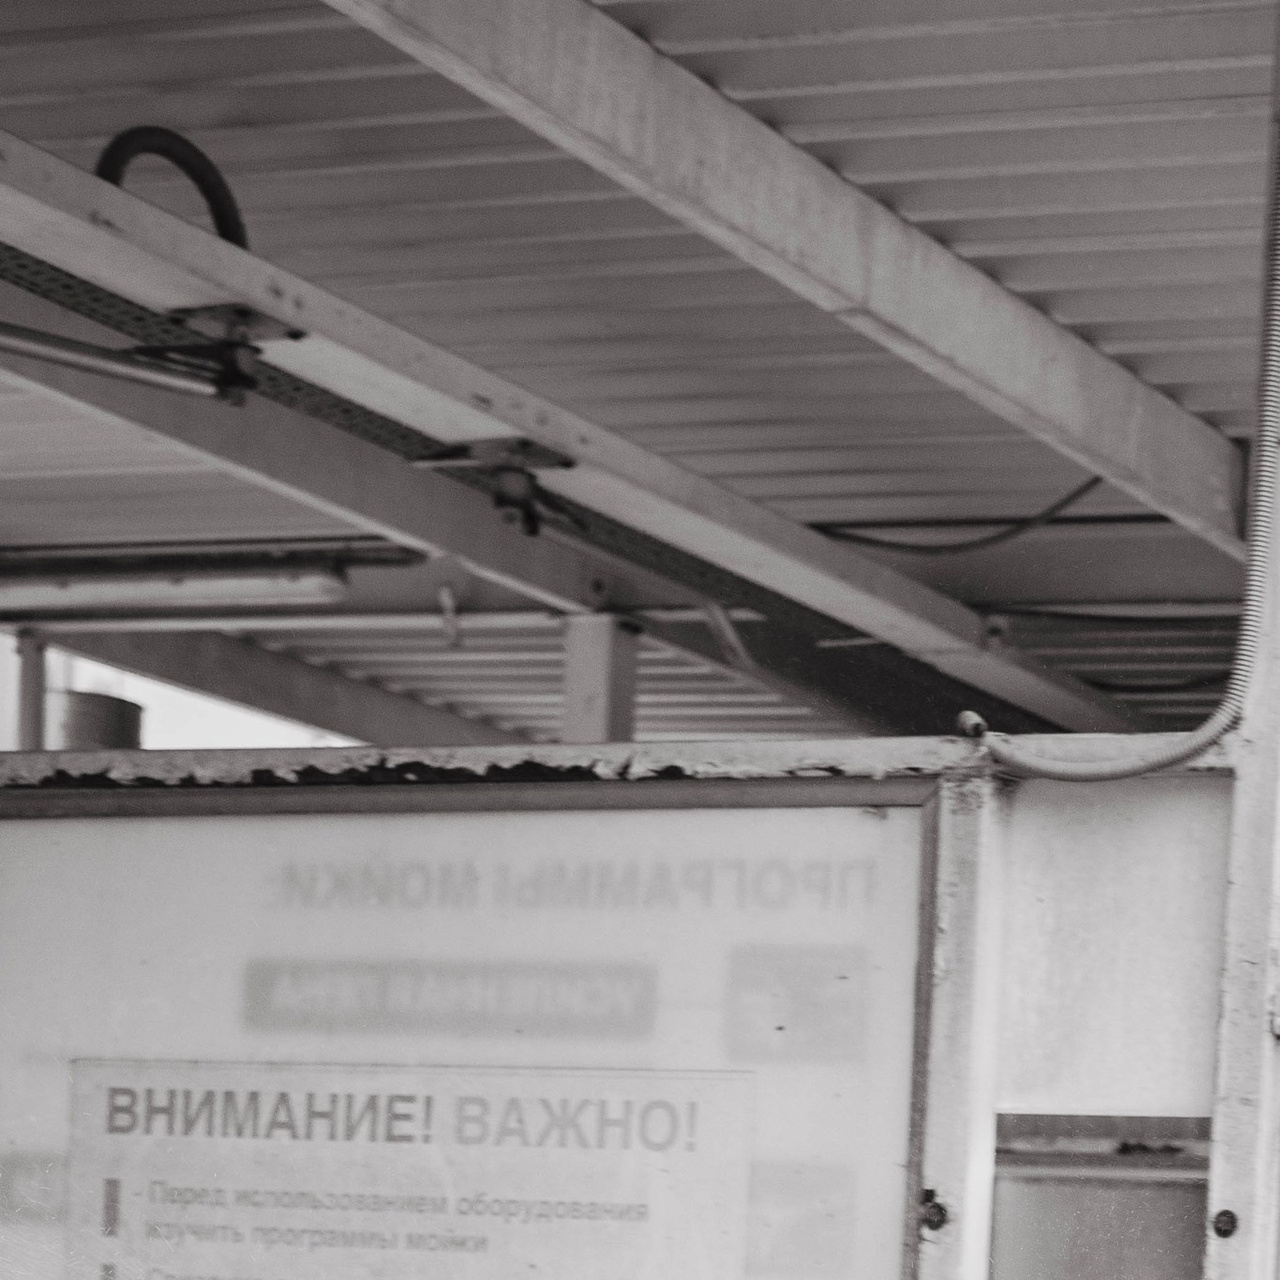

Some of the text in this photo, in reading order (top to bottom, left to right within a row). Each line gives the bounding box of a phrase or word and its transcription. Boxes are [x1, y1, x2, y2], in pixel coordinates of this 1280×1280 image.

[105, 1085, 700, 1152] ВНИМАНИЕ! ВАЖНО!
[148, 1179, 227, 1209] Перед
[233, 1187, 447, 1215] использованием
[455, 1191, 651, 1225] оборудования
[251, 1225, 399, 1252] программы
[405, 1228, 489, 1254] мойки
